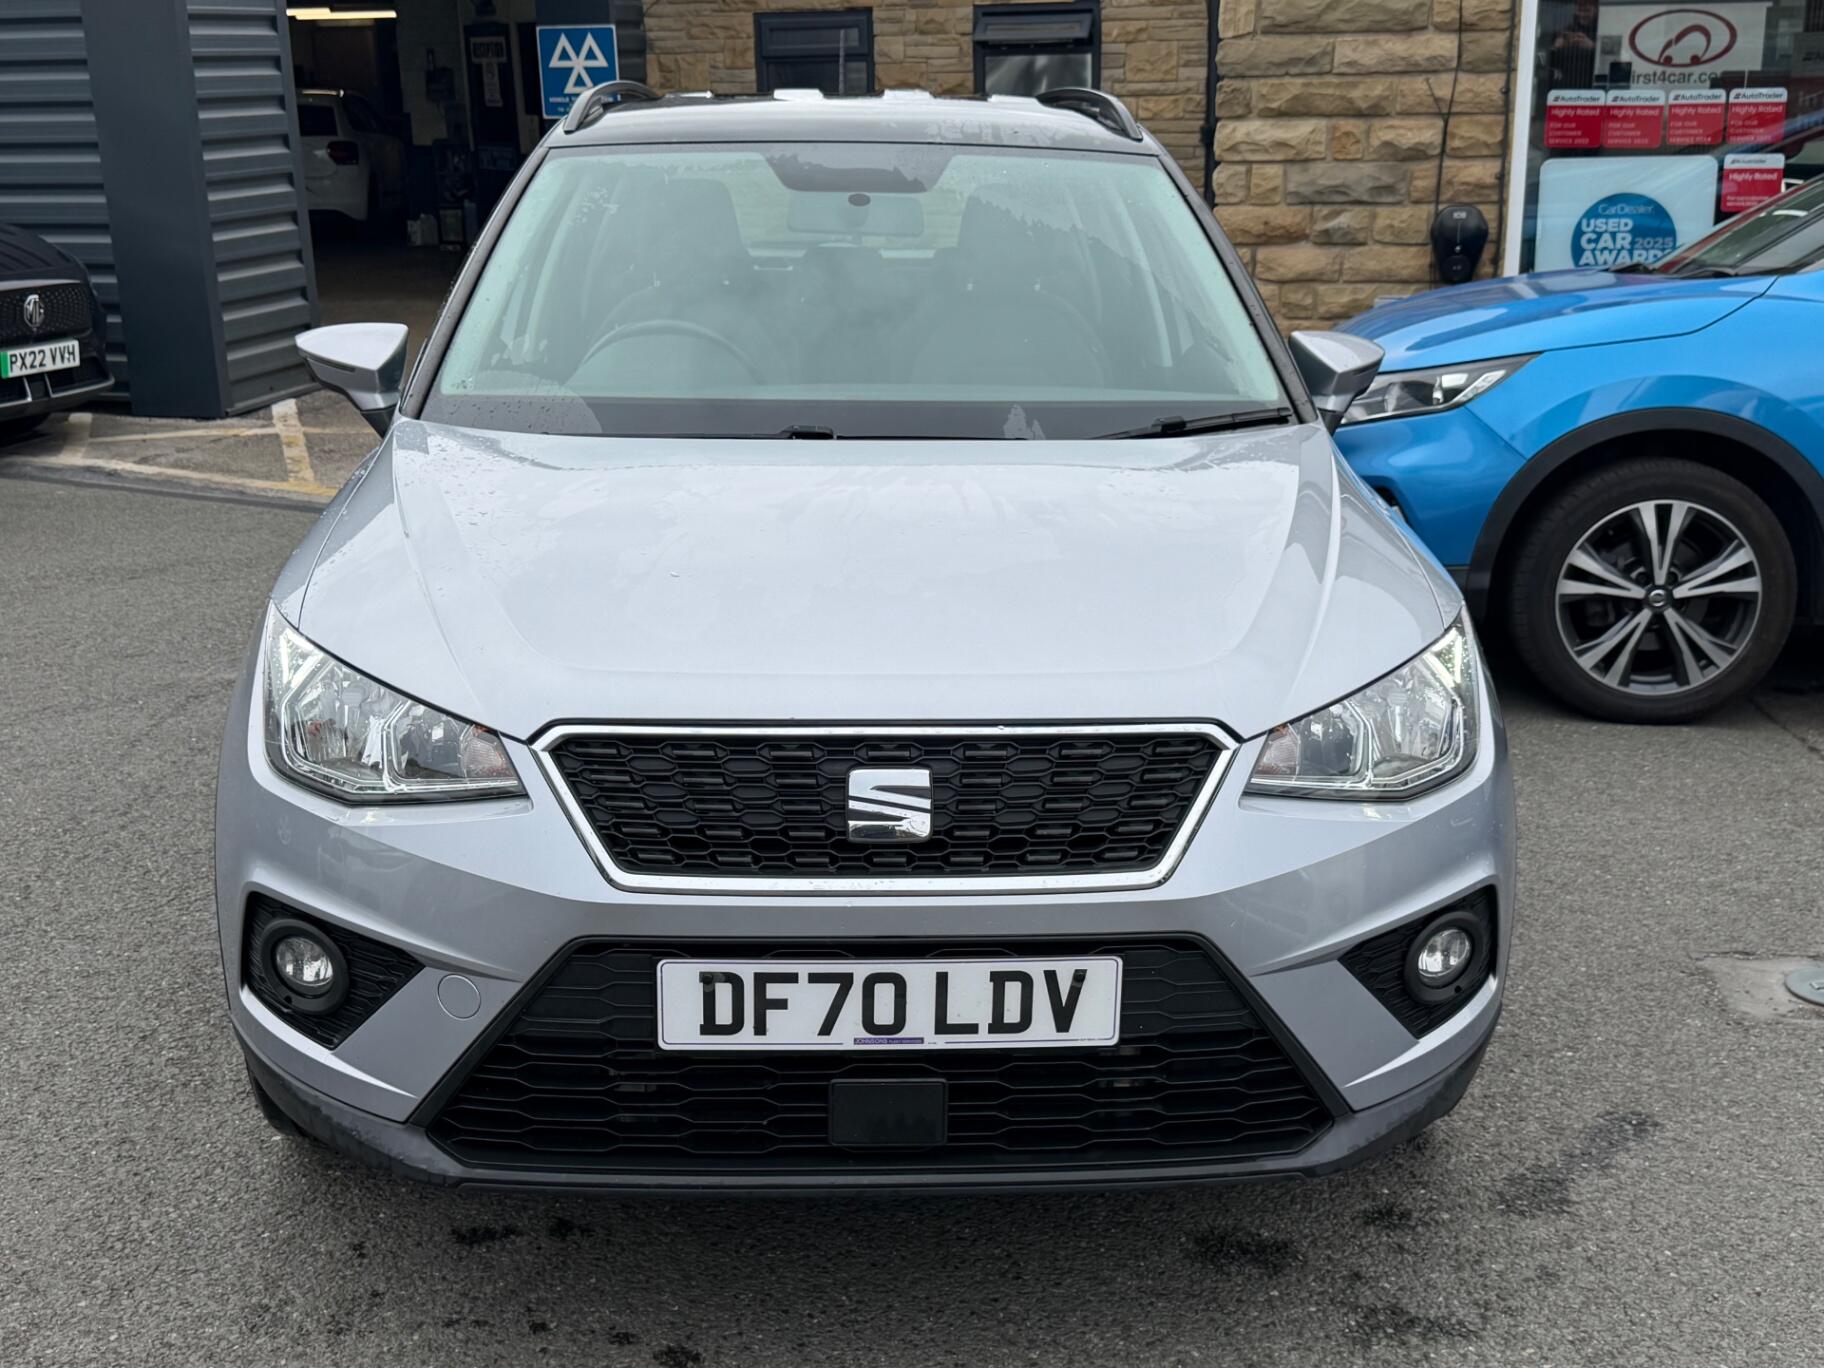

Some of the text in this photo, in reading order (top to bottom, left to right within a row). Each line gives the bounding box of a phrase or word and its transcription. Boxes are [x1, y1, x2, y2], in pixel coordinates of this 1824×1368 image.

[1631, 69, 1719, 85] irst4car.co
[1581, 218, 1634, 232] USED
[1580, 233, 1674, 250] CAR 2025
[9, 344, 76, 373] PX22 VVH
[699, 968, 1088, 1037] DF70 LDV
